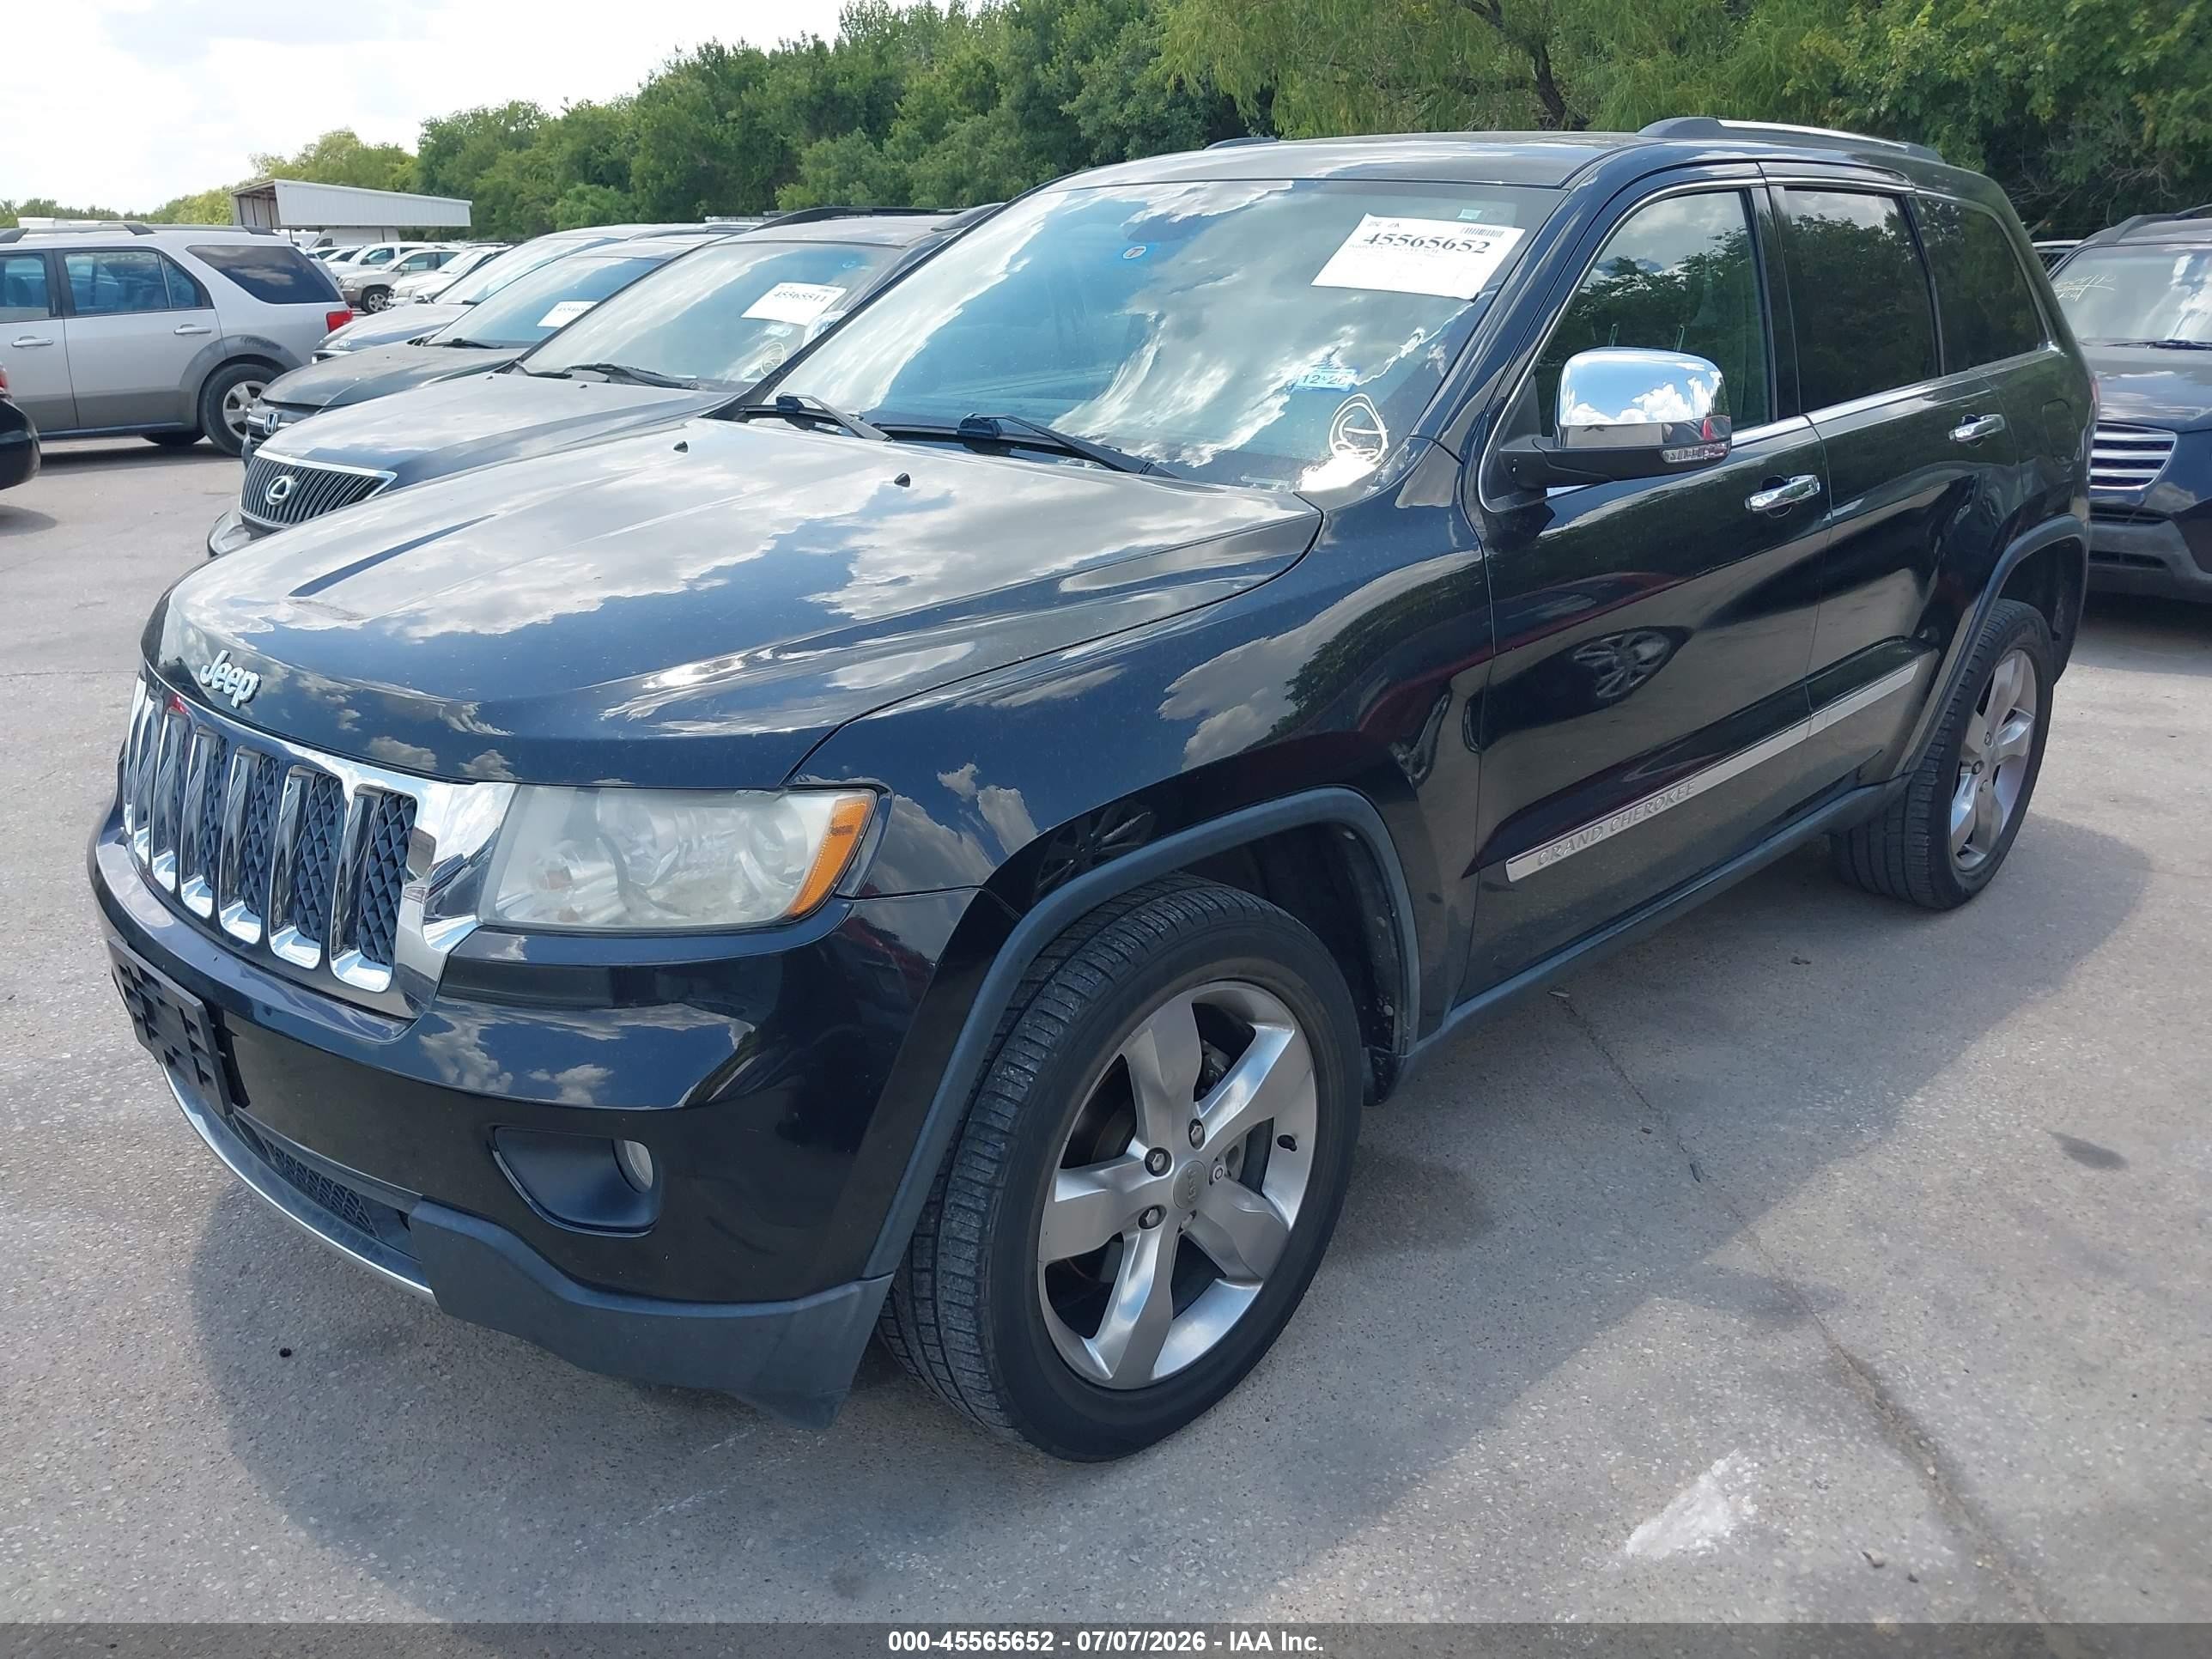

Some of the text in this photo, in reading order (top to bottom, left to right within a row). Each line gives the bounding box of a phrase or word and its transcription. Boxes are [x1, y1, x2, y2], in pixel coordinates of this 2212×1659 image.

[1363, 233, 1491, 254] 45565652
[200, 649, 261, 708] Jeep
[1537, 781, 1697, 866] GRAND CHEROKEE
